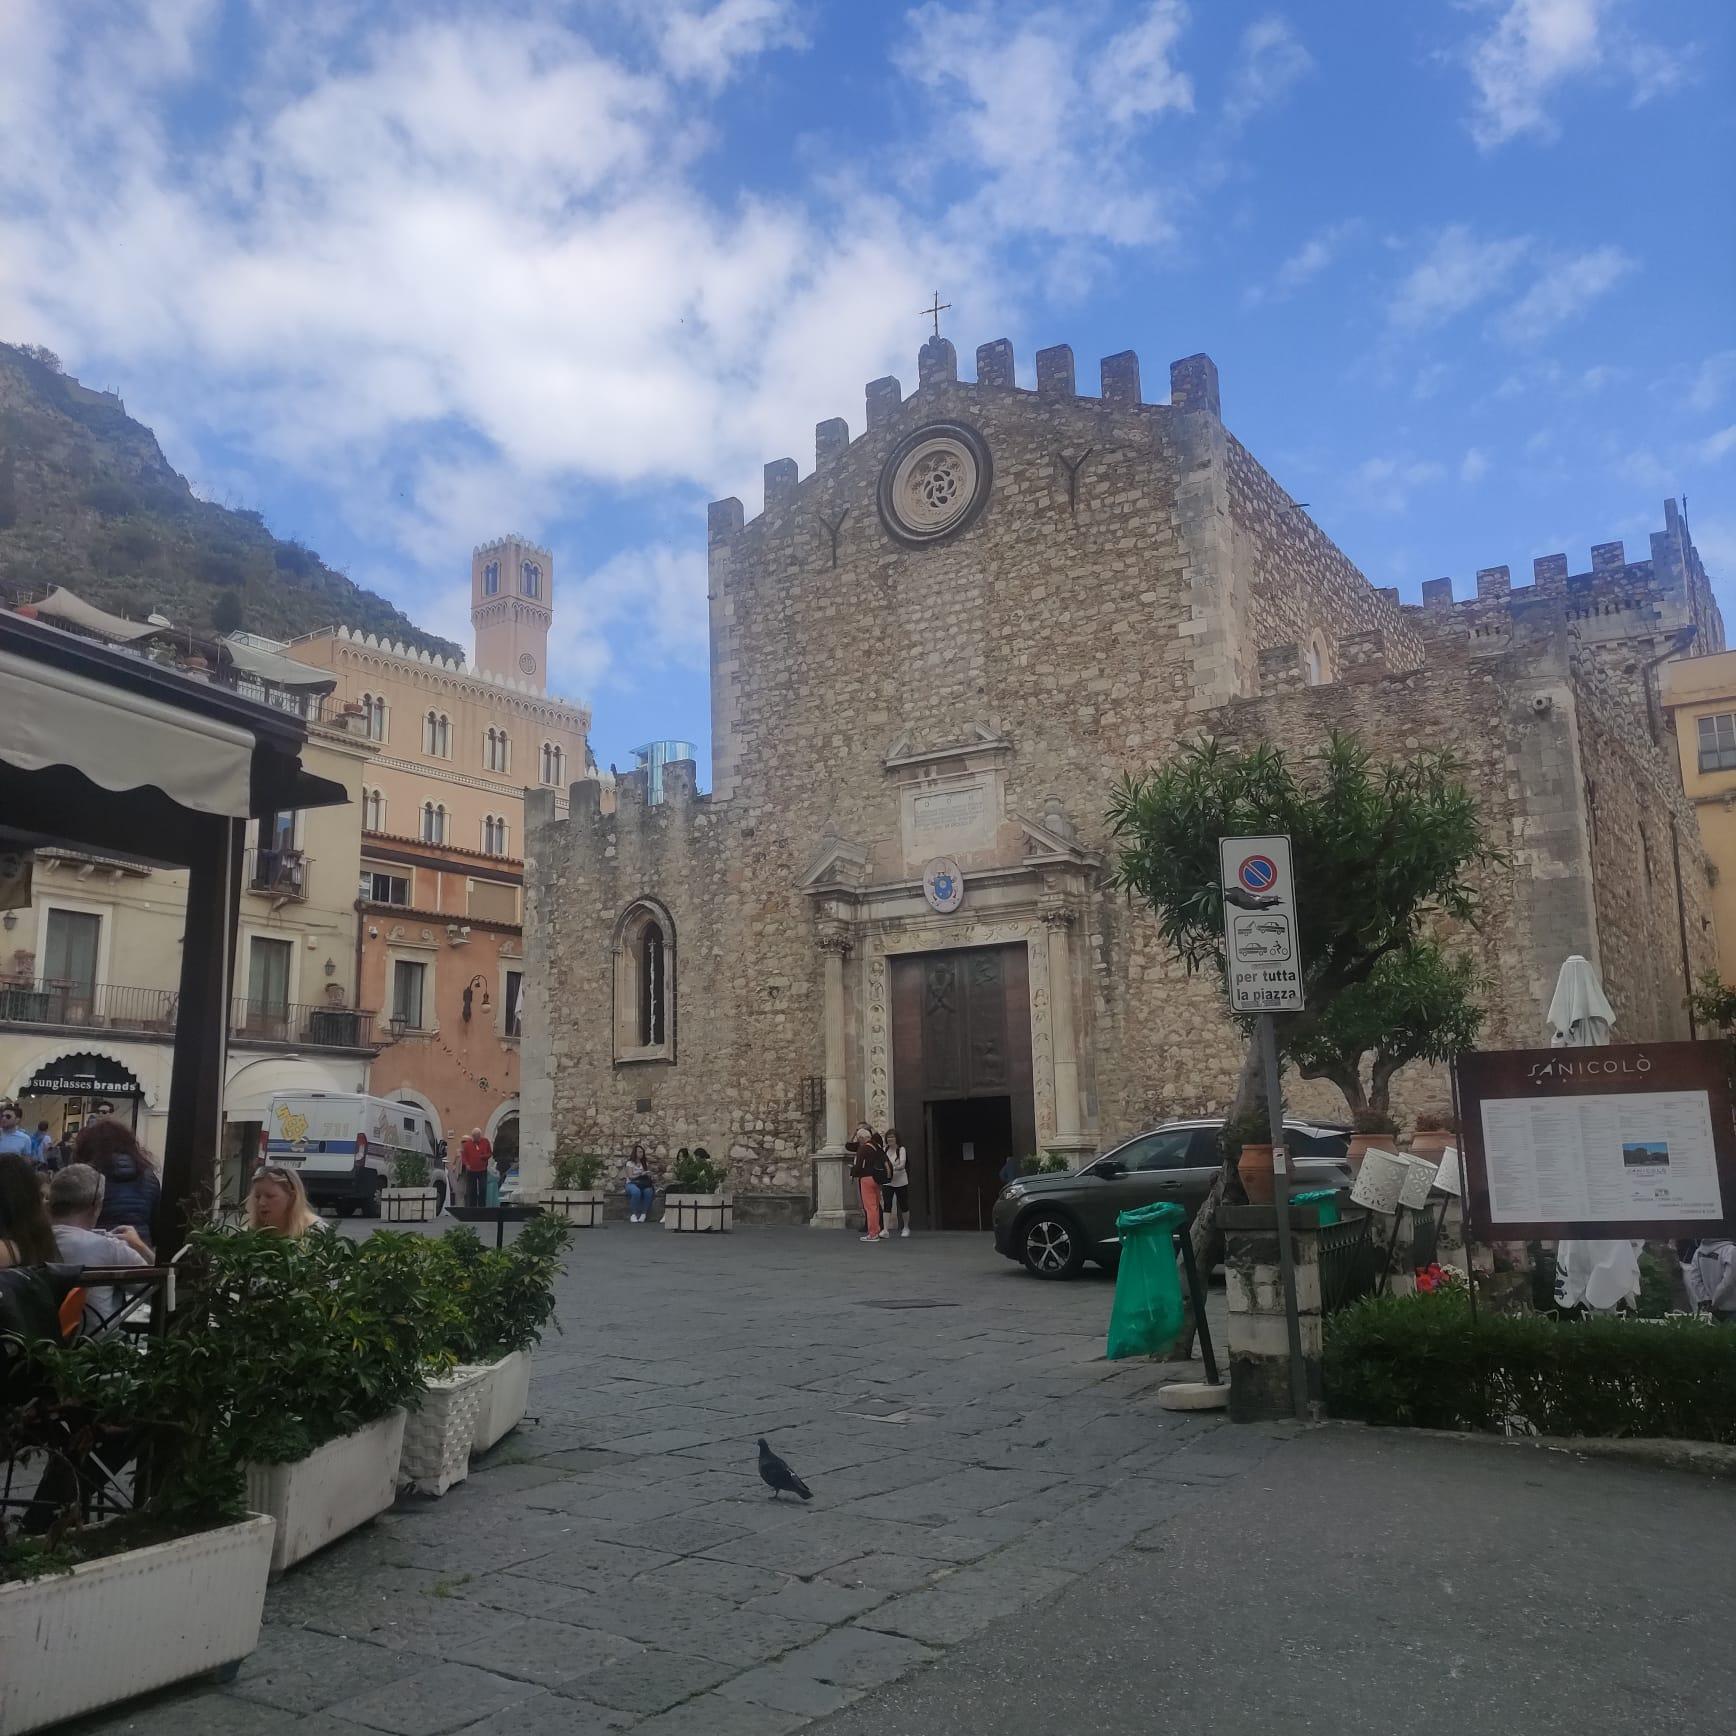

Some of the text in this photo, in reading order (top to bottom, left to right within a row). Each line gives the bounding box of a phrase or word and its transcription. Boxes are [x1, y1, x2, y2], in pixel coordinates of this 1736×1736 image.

[1236, 970, 1296, 985] per tutta
[1236, 988, 1296, 1002] la piazza
[33, 1078, 136, 1091] sunglasses brands
